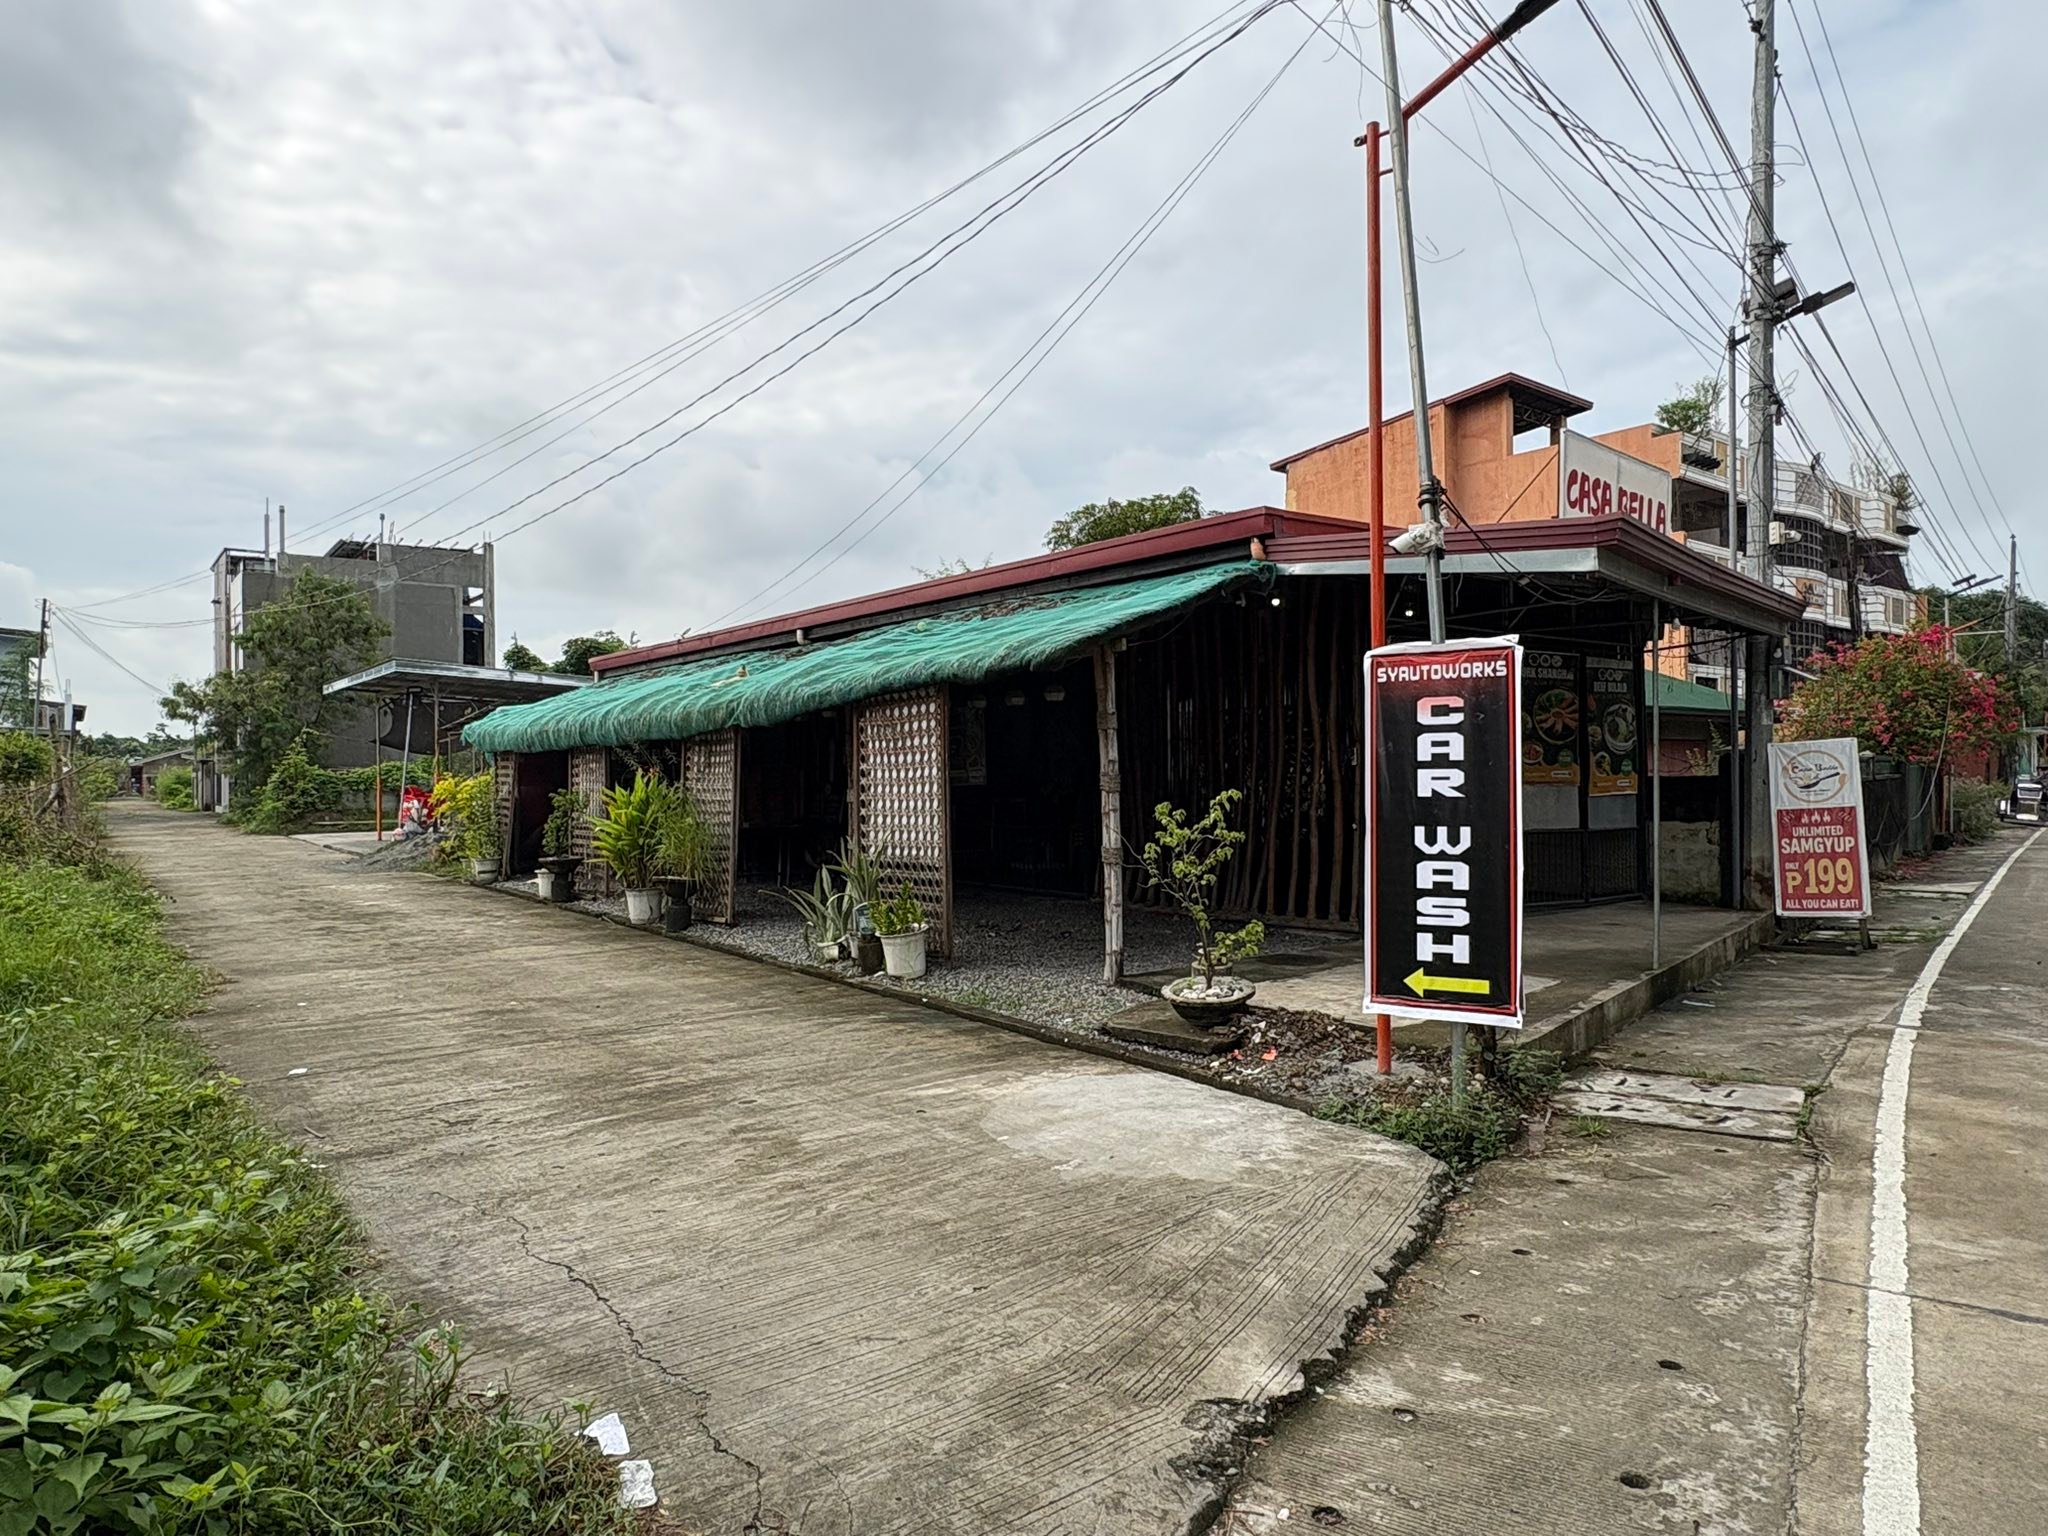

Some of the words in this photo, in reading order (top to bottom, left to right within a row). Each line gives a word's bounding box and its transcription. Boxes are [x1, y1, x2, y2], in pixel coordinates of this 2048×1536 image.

[1567, 469, 1612, 516] CASA
[1377, 660, 1507, 683] SYAUTOWORKS
[1416, 696, 1466, 798] CAR
[1792, 825, 1843, 837] UNLIMITED
[1781, 836, 1855, 854] SAMGYUP
[1414, 826, 1471, 964] WASH
[1786, 899, 1800, 908] ALL
[1801, 899, 1819, 908] YOU
[1820, 899, 1838, 908] CAN
[1840, 898, 1859, 908] EAT!
